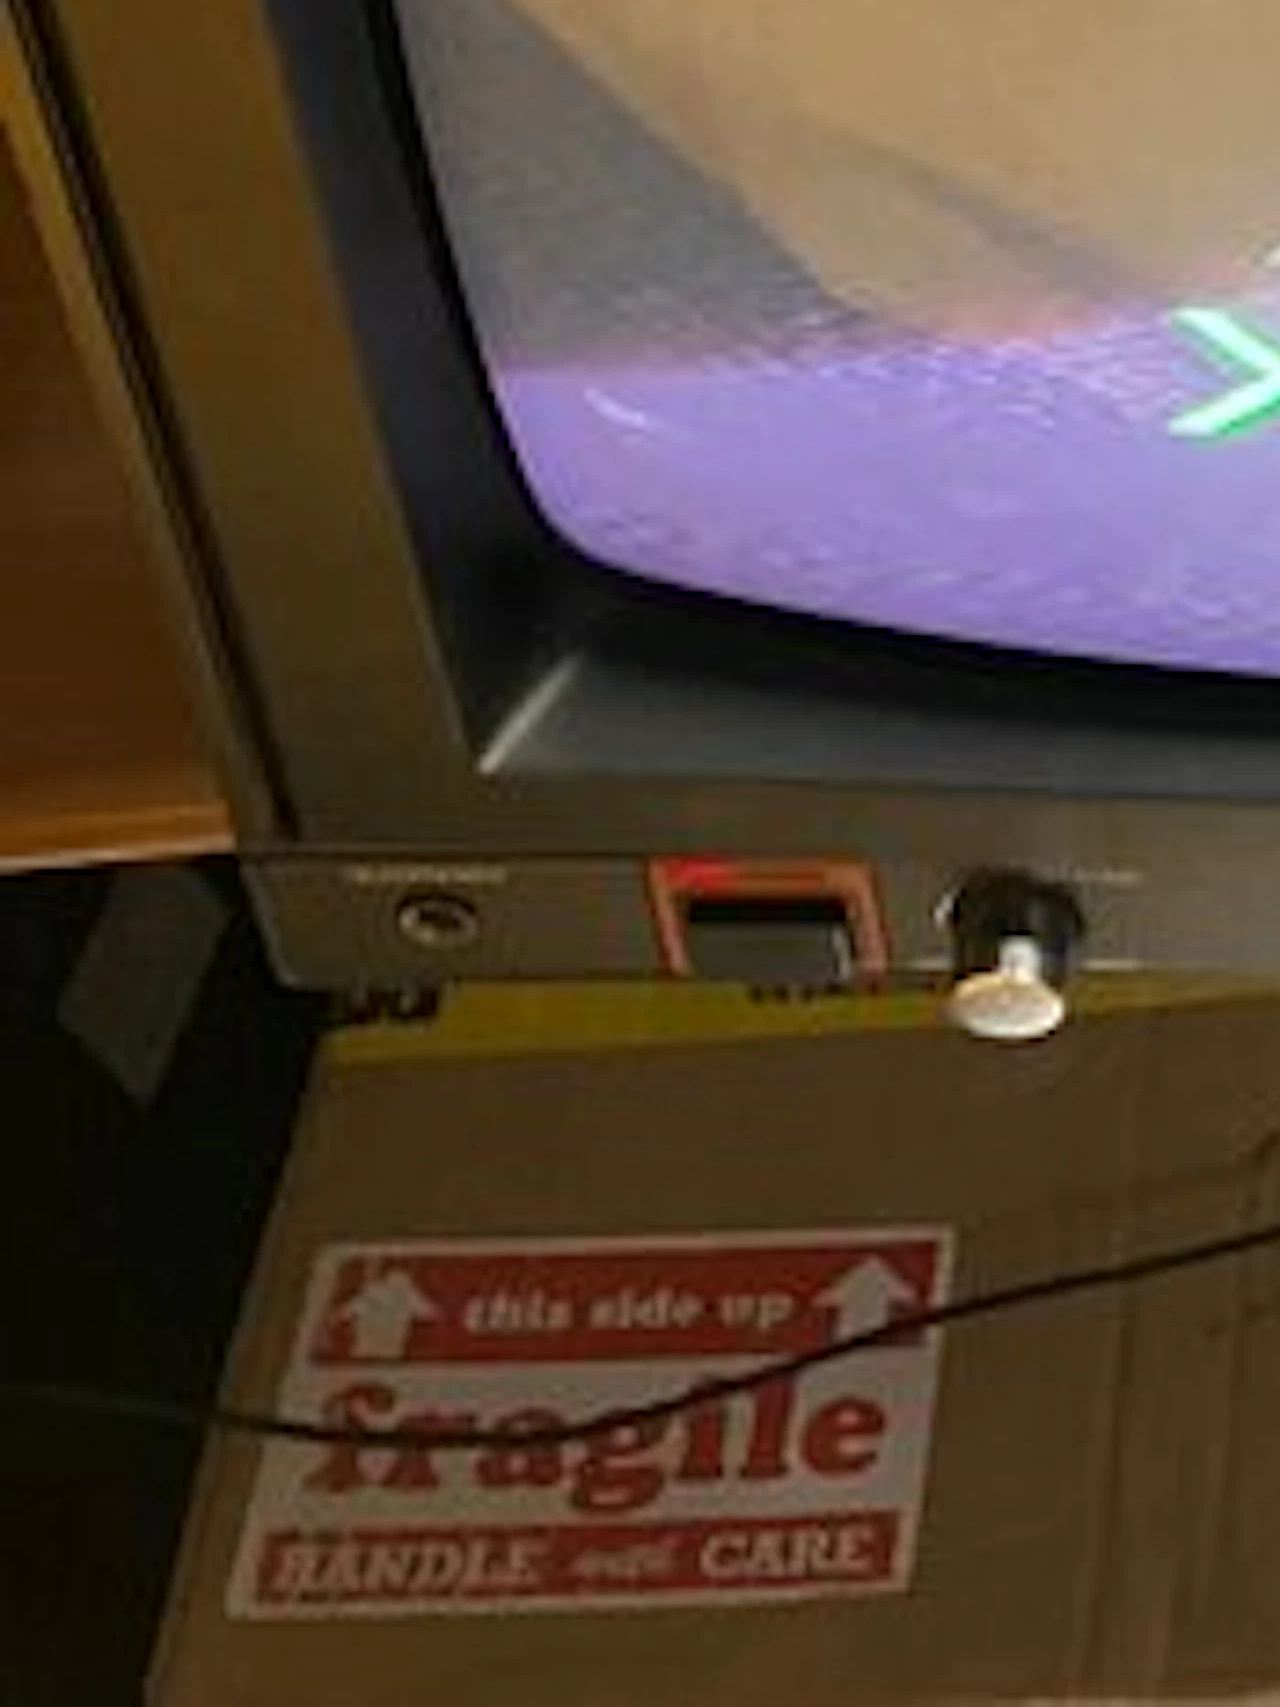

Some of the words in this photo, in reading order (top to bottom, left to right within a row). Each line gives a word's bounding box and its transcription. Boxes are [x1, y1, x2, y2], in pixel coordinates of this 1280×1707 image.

[464, 1293, 572, 1335] this
[588, 1286, 703, 1330] side
[720, 1291, 796, 1333] up
[303, 1375, 887, 1515] fragile
[274, 1541, 552, 1591] HANDLE
[699, 1525, 880, 1580] CARE
